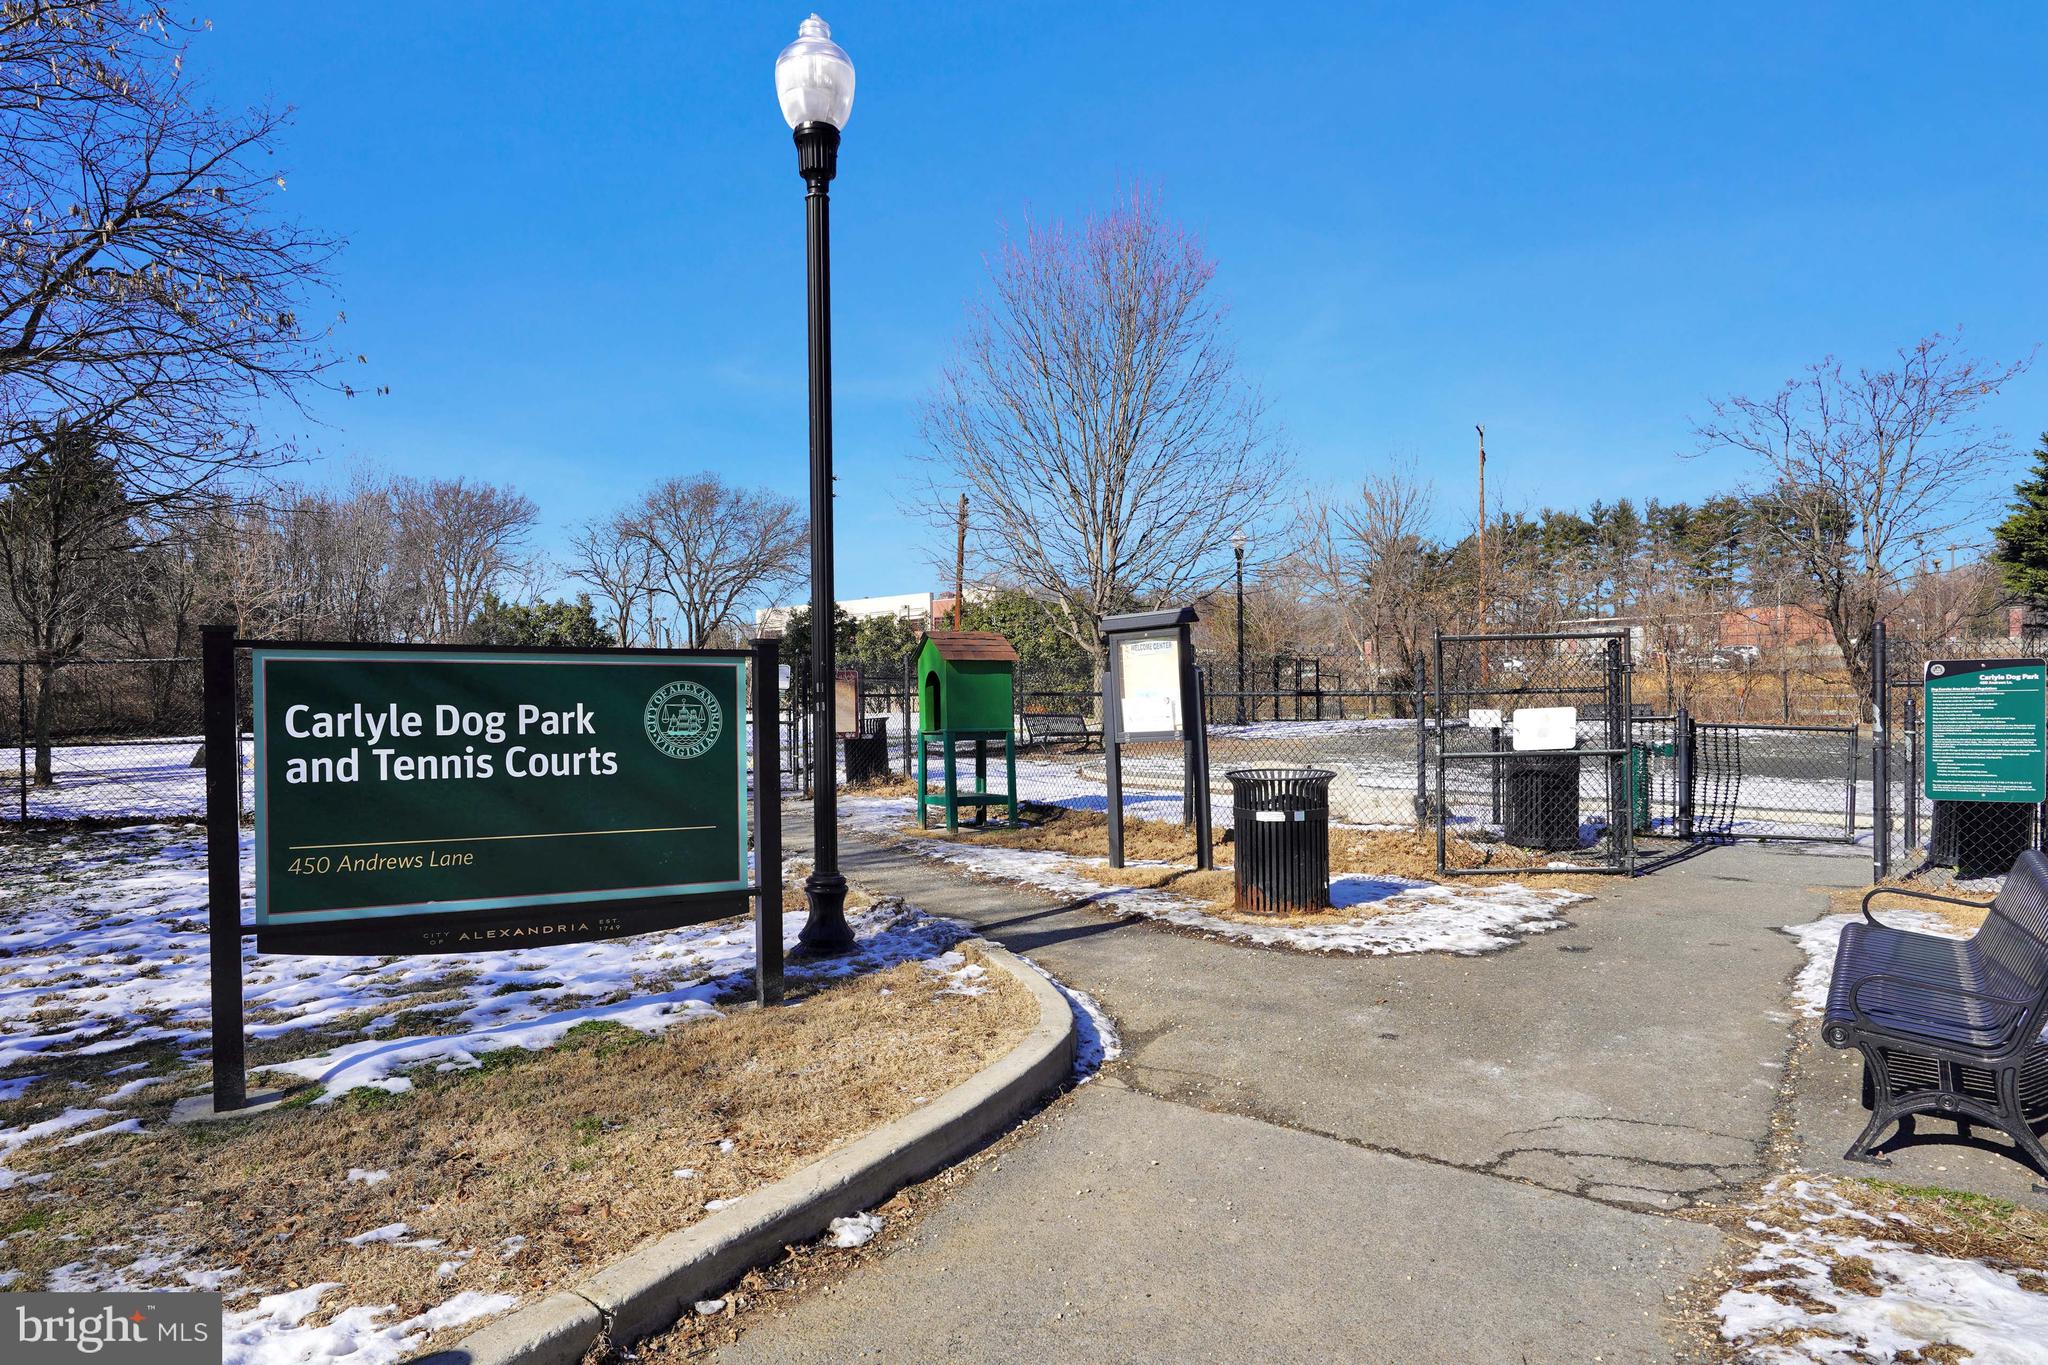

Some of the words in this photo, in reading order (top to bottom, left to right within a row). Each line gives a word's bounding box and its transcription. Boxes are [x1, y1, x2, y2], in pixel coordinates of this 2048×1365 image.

[1153, 641, 1172, 650] CENTER
[1979, 673, 2005, 681] Carlyle
[647, 704, 657, 733] CITY
[654, 689, 668, 704] OF
[669, 683, 720, 733] ALEXANDRIA
[285, 703, 423, 746] Carlyle
[435, 704, 507, 744] Dog
[518, 702, 596, 735] Park
[655, 736, 713, 756] VIRGINIA
[286, 747, 359, 784] and
[372, 745, 494, 781] Tennis
[505, 745, 618, 778] Courts
[287, 856, 331, 875] 450
[336, 853, 424, 873] Andrews
[429, 850, 474, 868] Lane
[423, 931, 450, 939] CITY
[458, 922, 589, 941] ALEXANDRIA
